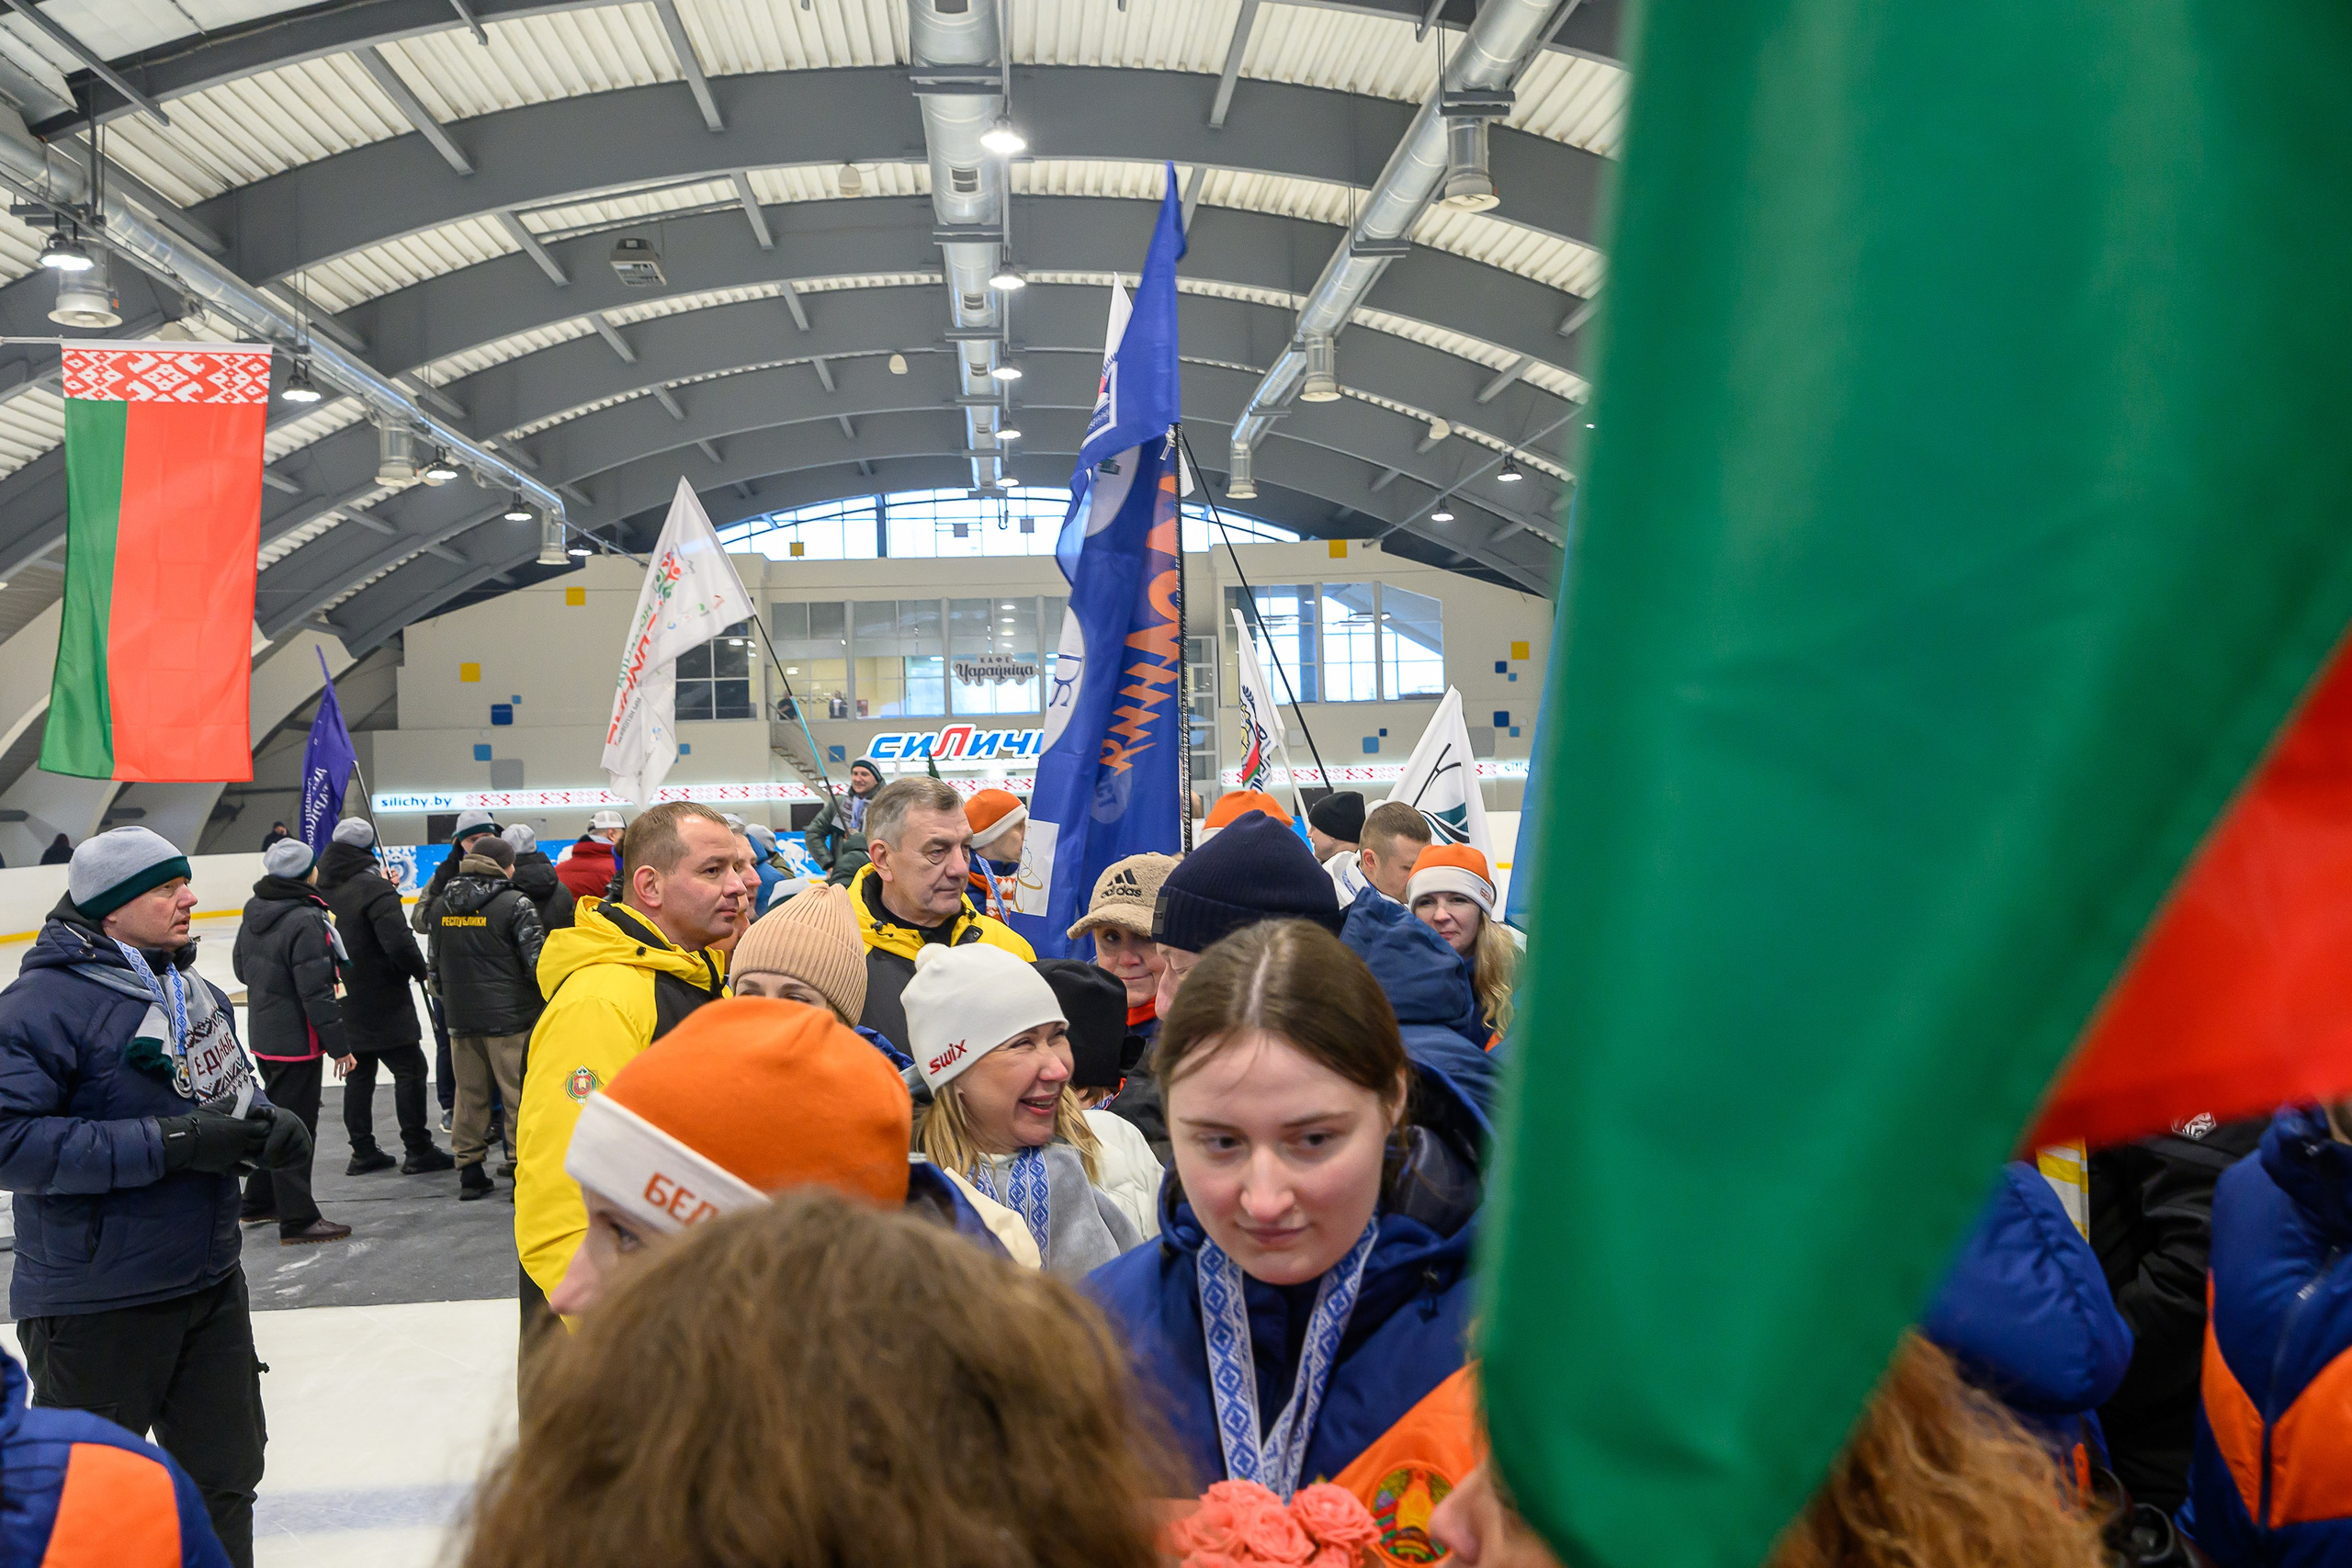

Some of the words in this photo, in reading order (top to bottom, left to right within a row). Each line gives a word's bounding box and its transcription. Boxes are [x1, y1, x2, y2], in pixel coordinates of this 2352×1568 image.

[979, 656, 1011, 664] КАФЕ
[381, 795, 452, 807] silichy.by
[1100, 885, 1142, 898] addas
[441, 916, 487, 928] РЕСПУБЛИКИ
[929, 1039, 967, 1075] swix
